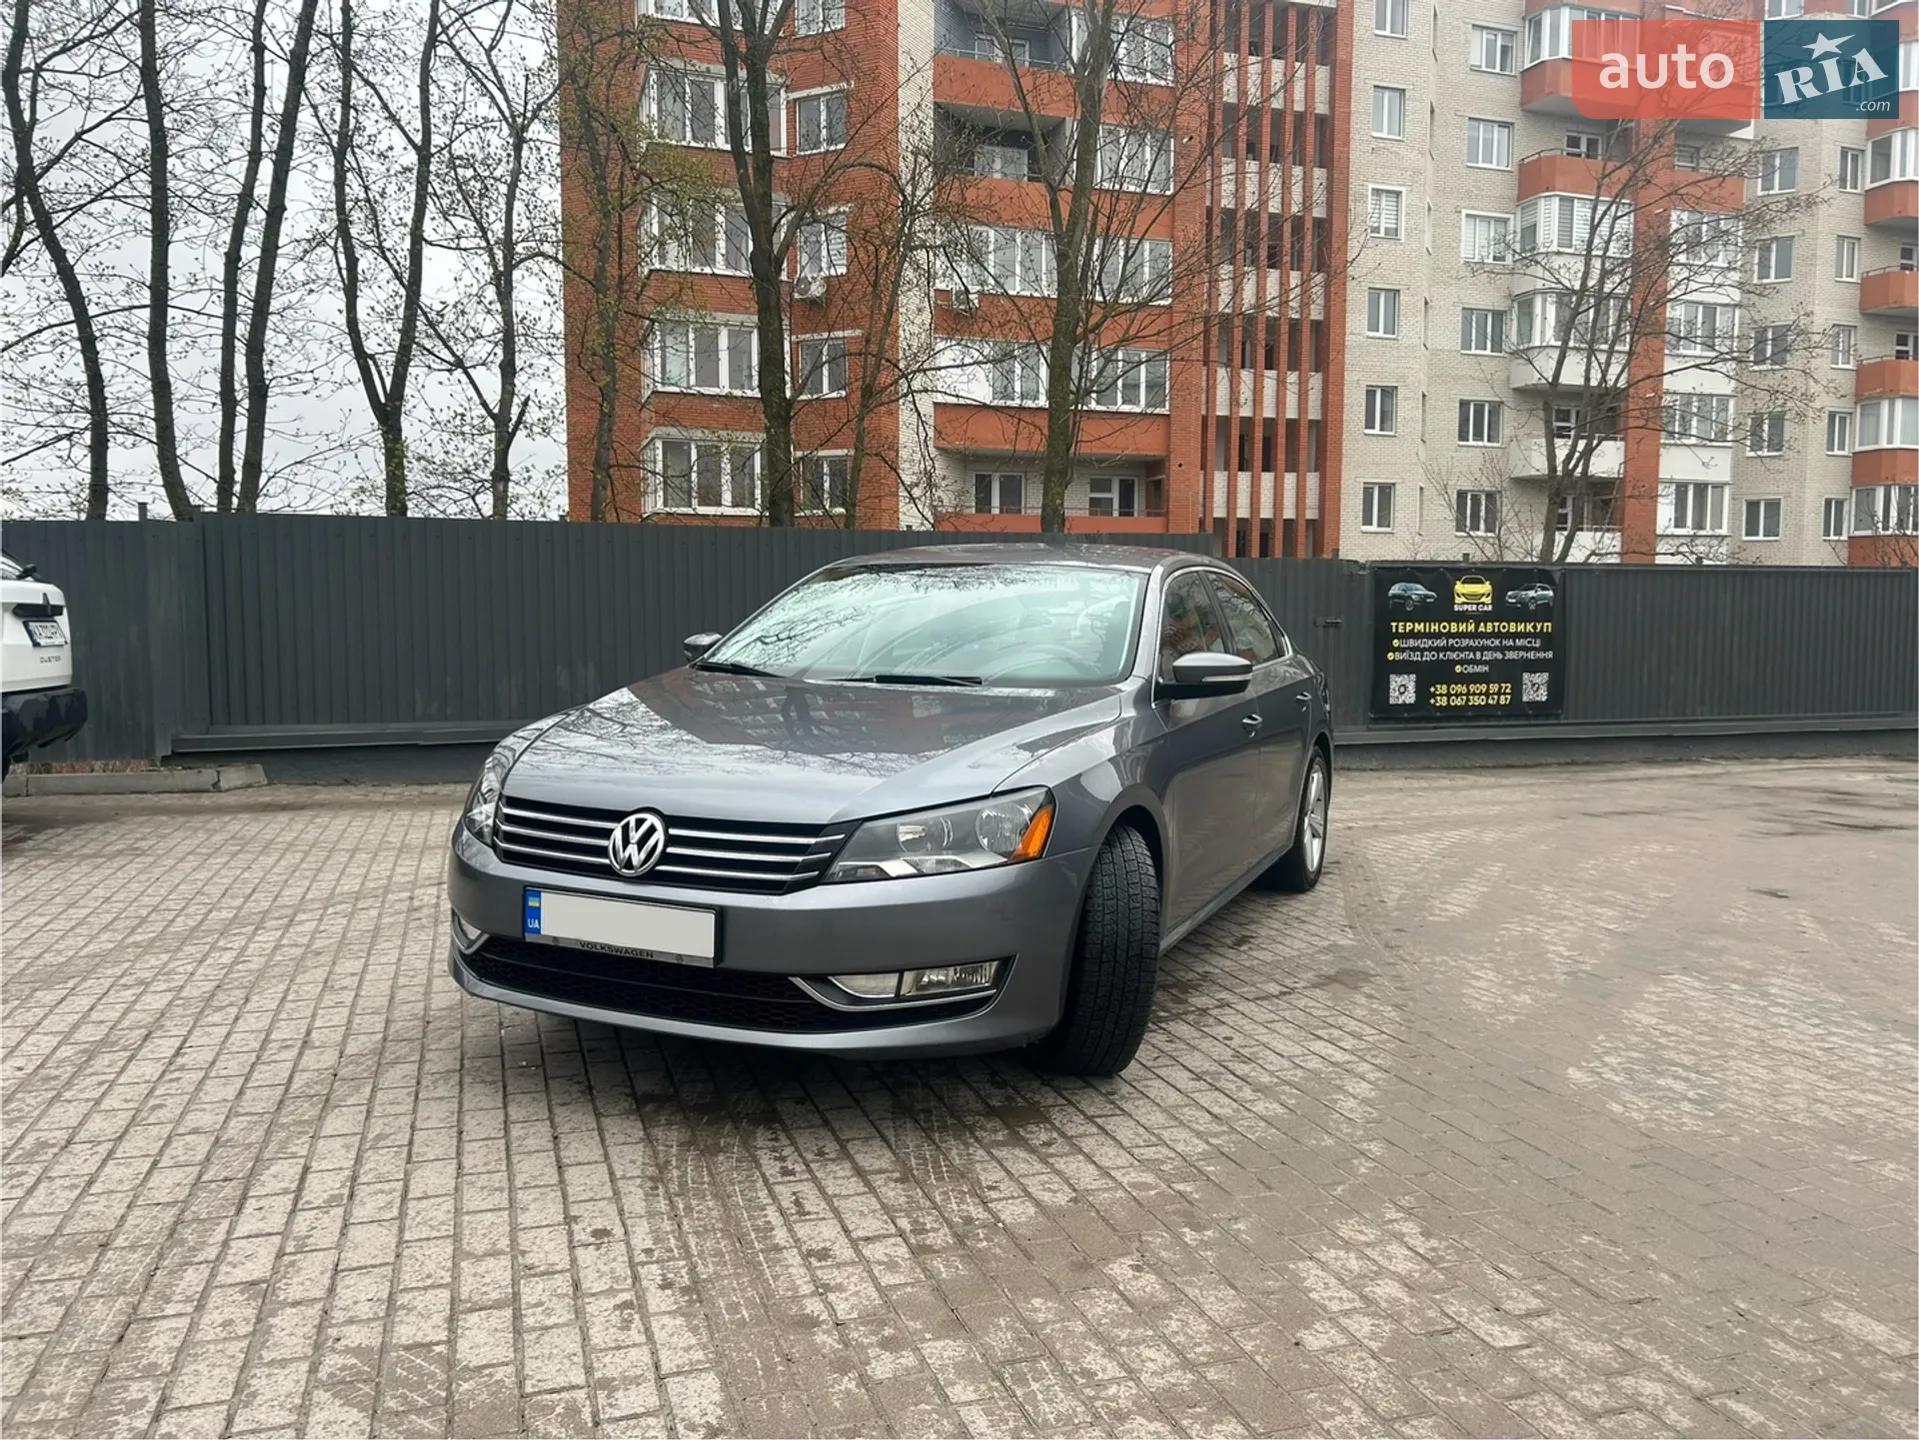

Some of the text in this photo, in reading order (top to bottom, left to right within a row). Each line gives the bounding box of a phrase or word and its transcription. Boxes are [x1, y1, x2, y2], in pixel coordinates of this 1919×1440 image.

[1390, 619, 1552, 633] ТЕРМІНОВИЙ АВТОВИКУП
[1400, 637, 1541, 648] ШВИДКИЙ РОЗРАХУНОК НА МІСЦІ
[1394, 650, 1553, 661] ВИЇЗД ДО КЛІЄНТА В ДЕНЬ ЗВЕРНЕННЯ
[1462, 664, 1489, 673] ОБМІН
[1429, 683, 1512, 694] +38 096 909 59 72
[1429, 695, 1512, 706] +38 067 350 47 87
[527, 918, 540, 929] UA
[579, 941, 654, 958] VOLKSWAGEN
